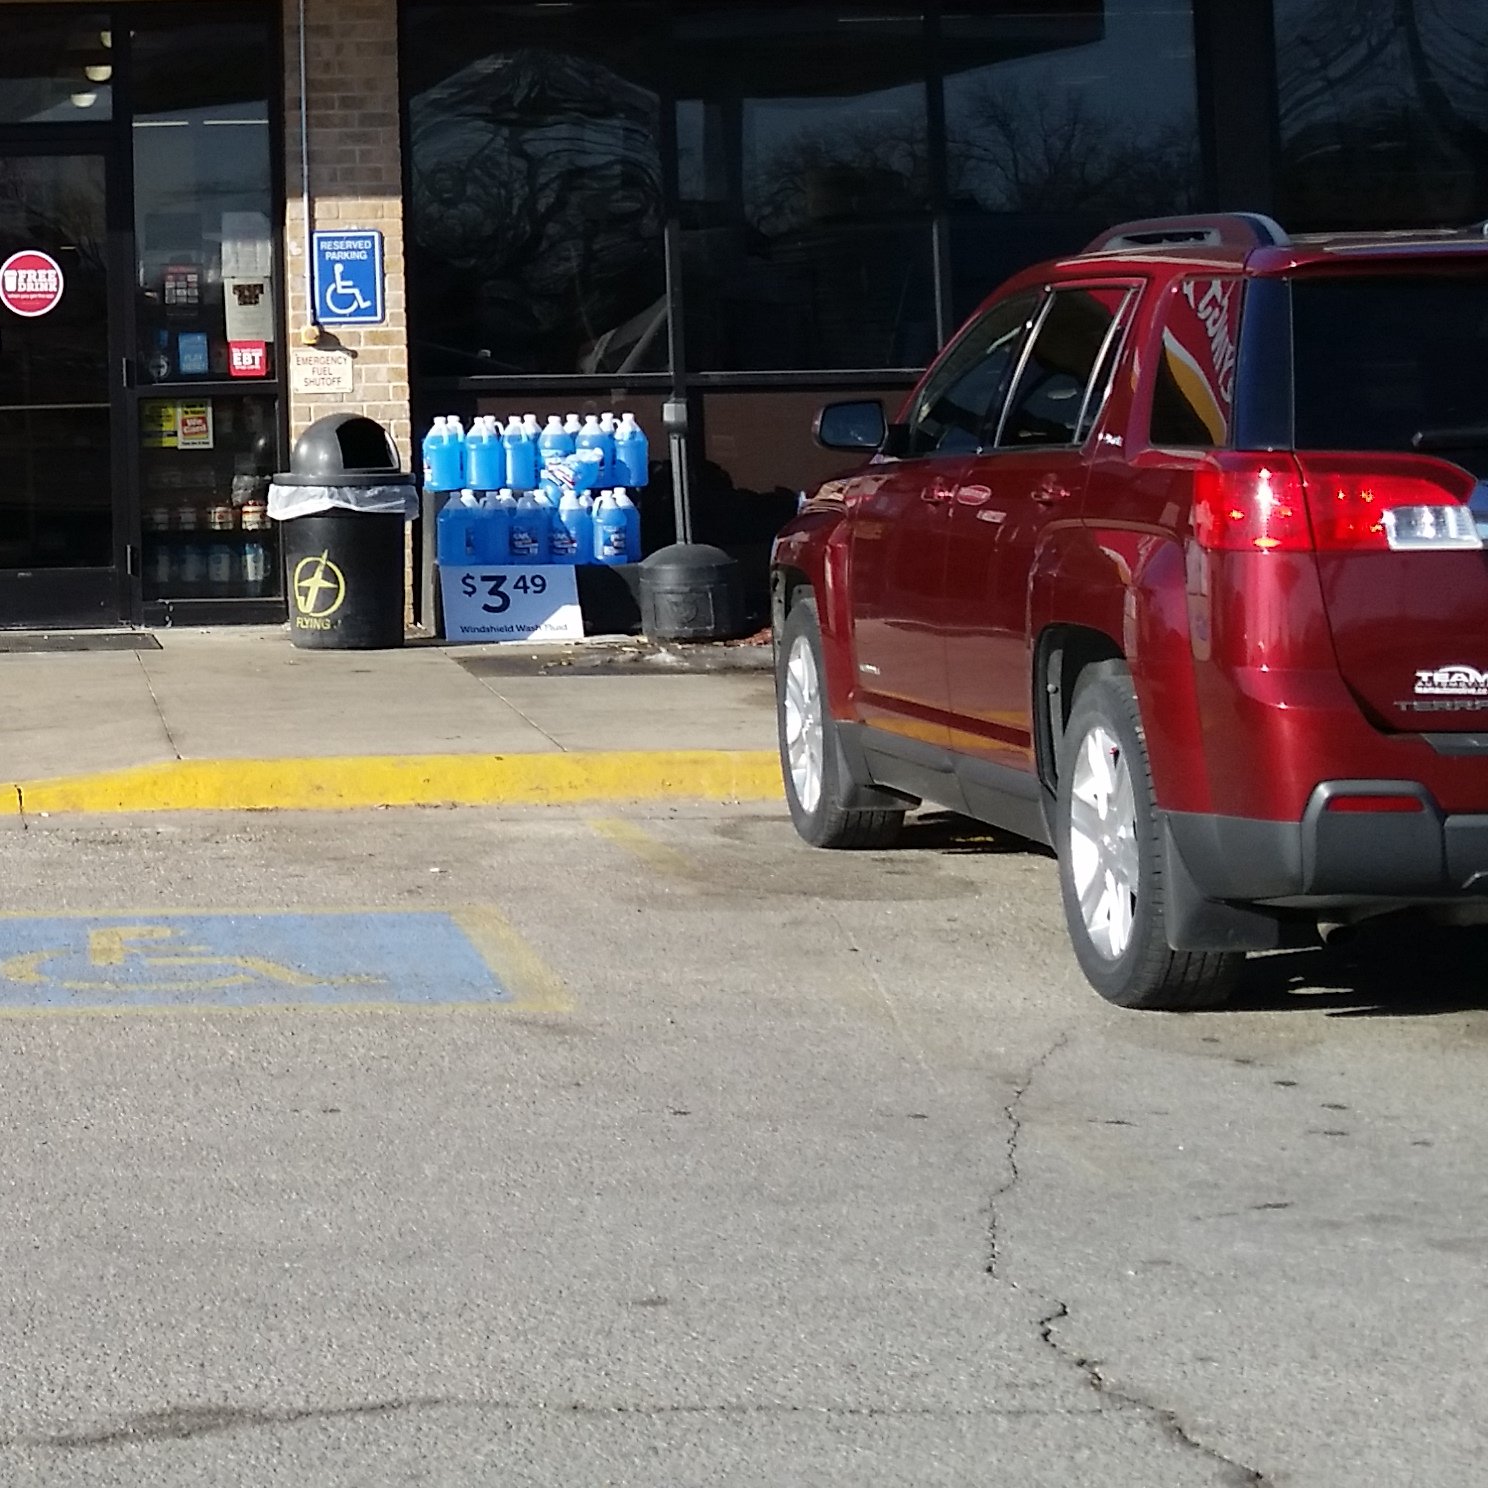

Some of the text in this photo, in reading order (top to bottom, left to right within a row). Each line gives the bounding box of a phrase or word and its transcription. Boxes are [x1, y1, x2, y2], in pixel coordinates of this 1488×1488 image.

[320, 240, 372, 250] RESERVED
[325, 250, 368, 261] PARKING
[17, 269, 57, 282] FREE
[17, 282, 58, 292] DRINK
[232, 352, 262, 365] EBT
[296, 356, 347, 366] EMERGENCY
[312, 367, 333, 376] FUEL
[304, 377, 342, 387] SHUTOFF
[459, 624, 514, 633] Windshield
[515, 623, 541, 633] Wash
[1415, 671, 1488, 683] TEAM
